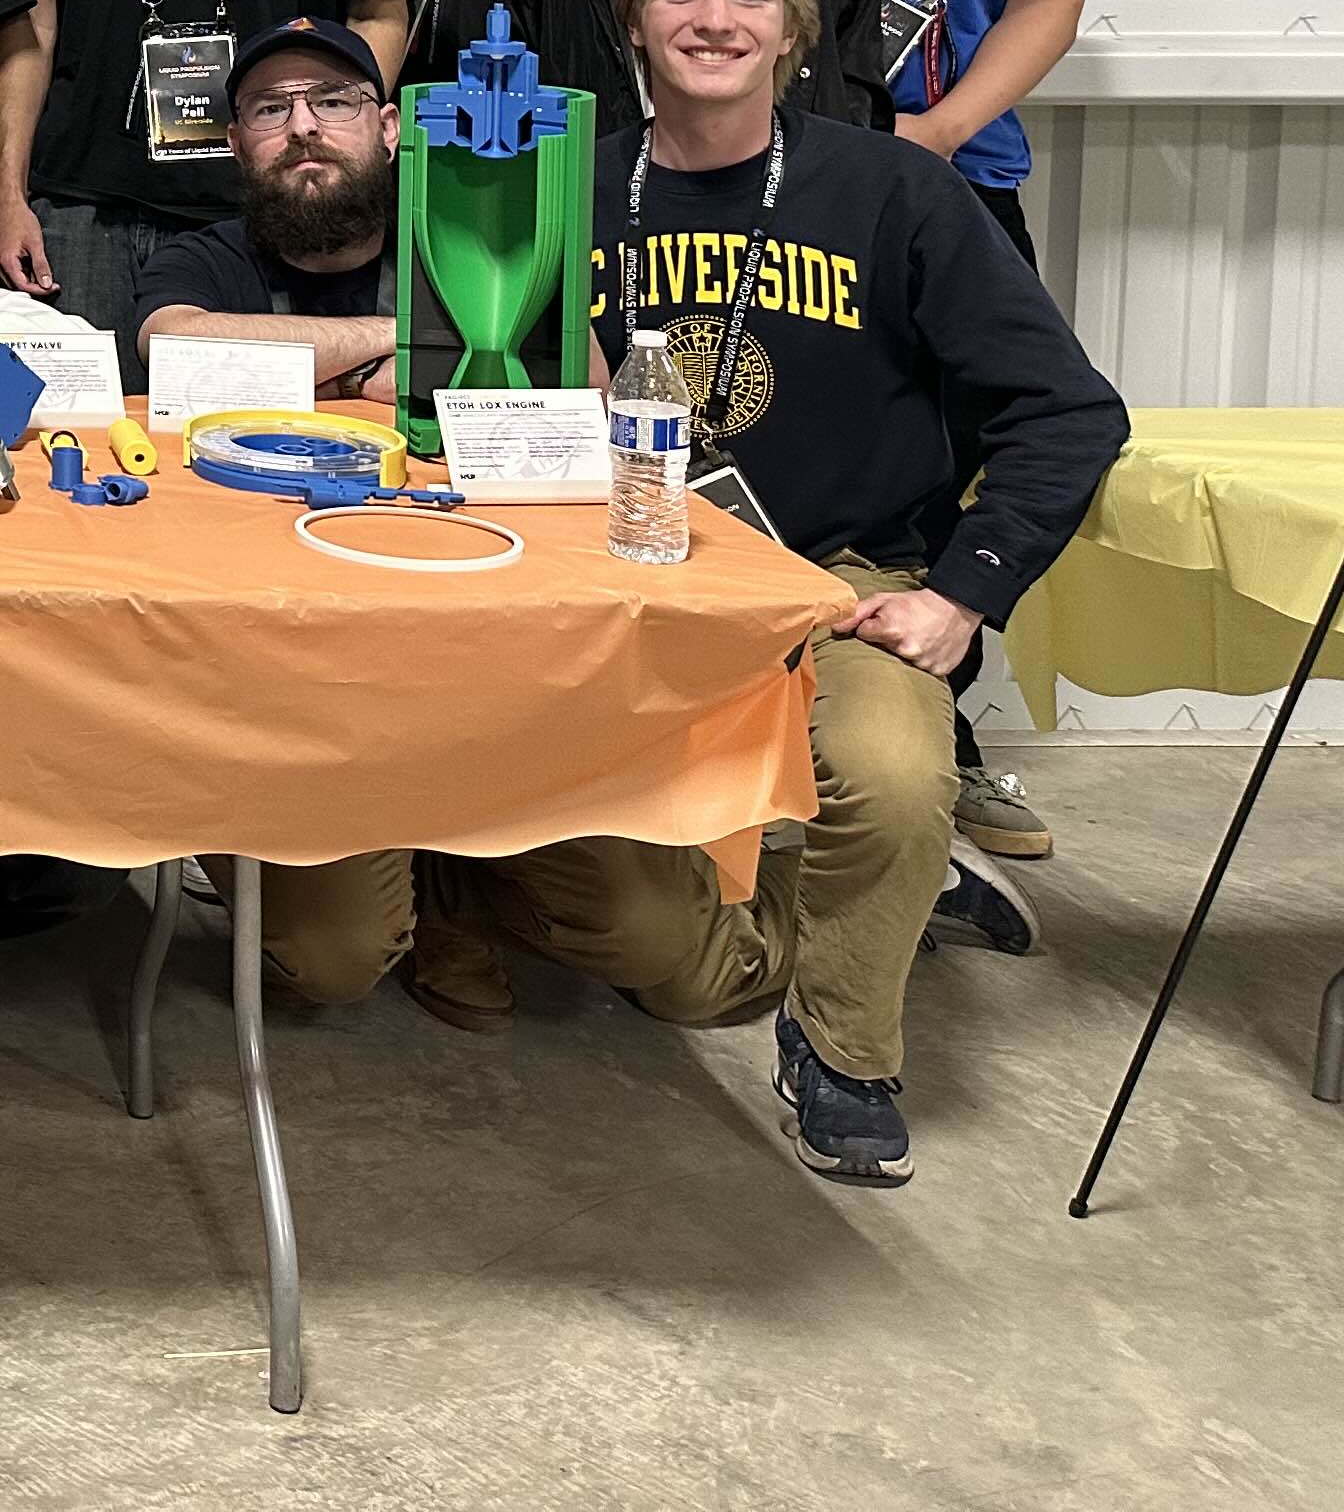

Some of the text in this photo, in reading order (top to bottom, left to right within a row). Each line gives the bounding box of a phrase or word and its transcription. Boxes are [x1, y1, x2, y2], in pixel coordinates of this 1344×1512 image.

[175, 95, 210, 108] Dylan
[181, 107, 205, 118] Pell
[625, 247, 638, 311] SYMPOSIUM
[715, 241, 764, 397] LIQUID PROPULSION SYMPOSIUM
[30, 341, 62, 350] VALVE
[446, 401, 546, 410] ETOH LOX ENGINE
